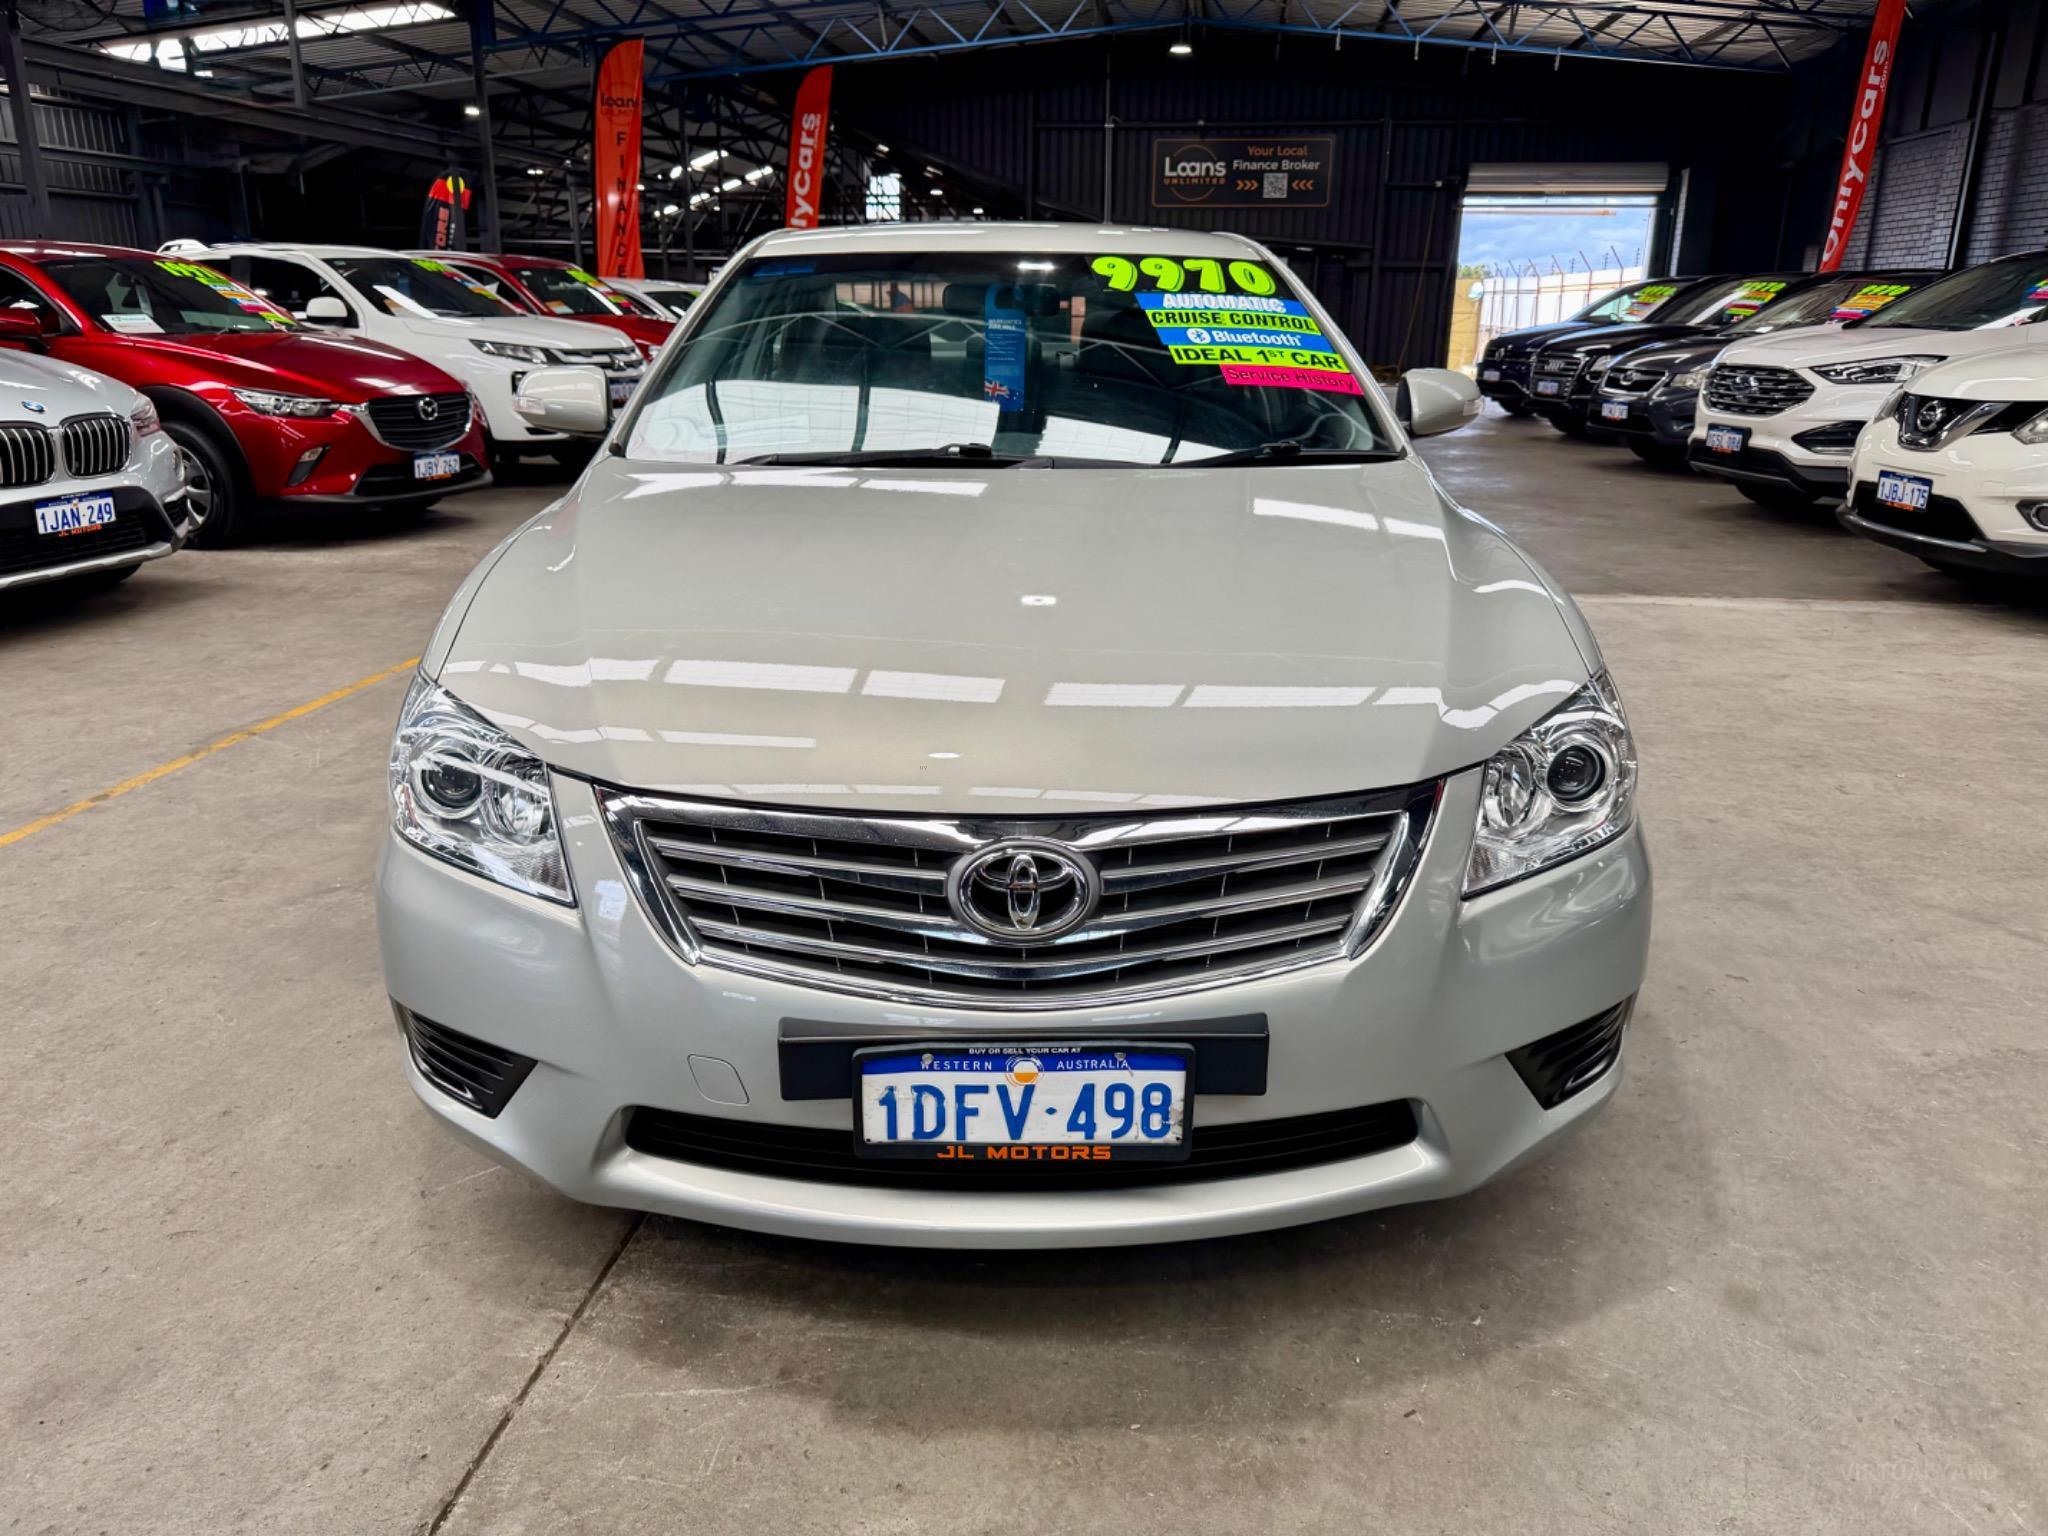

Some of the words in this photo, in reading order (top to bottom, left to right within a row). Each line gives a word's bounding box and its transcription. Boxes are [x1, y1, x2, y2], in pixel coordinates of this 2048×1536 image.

[1248, 146, 1273, 157] Your
[1278, 145, 1308, 156] Local
[1823, 40, 1889, 262] OnlyCars
[790, 113, 816, 227] lyCars
[1164, 157, 1227, 177] Loans
[1233, 160, 1278, 171] Finance
[1281, 160, 1320, 171] Broker
[1163, 177, 1227, 185] UNLIMITED
[616, 131, 627, 278] FINANCE
[1091, 256, 1276, 295] 9970
[1163, 293, 1287, 314] AUTOMATIC
[1151, 311, 1223, 325] CRUISE
[1230, 312, 1315, 332] CONTROL
[1212, 331, 1299, 346] Bluetooth
[1175, 347, 1251, 363] IDEAL
[1292, 352, 1341, 370] CAR
[1228, 368, 1290, 384] Service
[1295, 373, 1354, 390] History
[920, 1060, 992, 1071] WESTERN
[1056, 1059, 1129, 1070] AUSTRALIA
[936, 1145, 974, 1160] JL
[987, 1145, 1112, 1160] MOTORS
